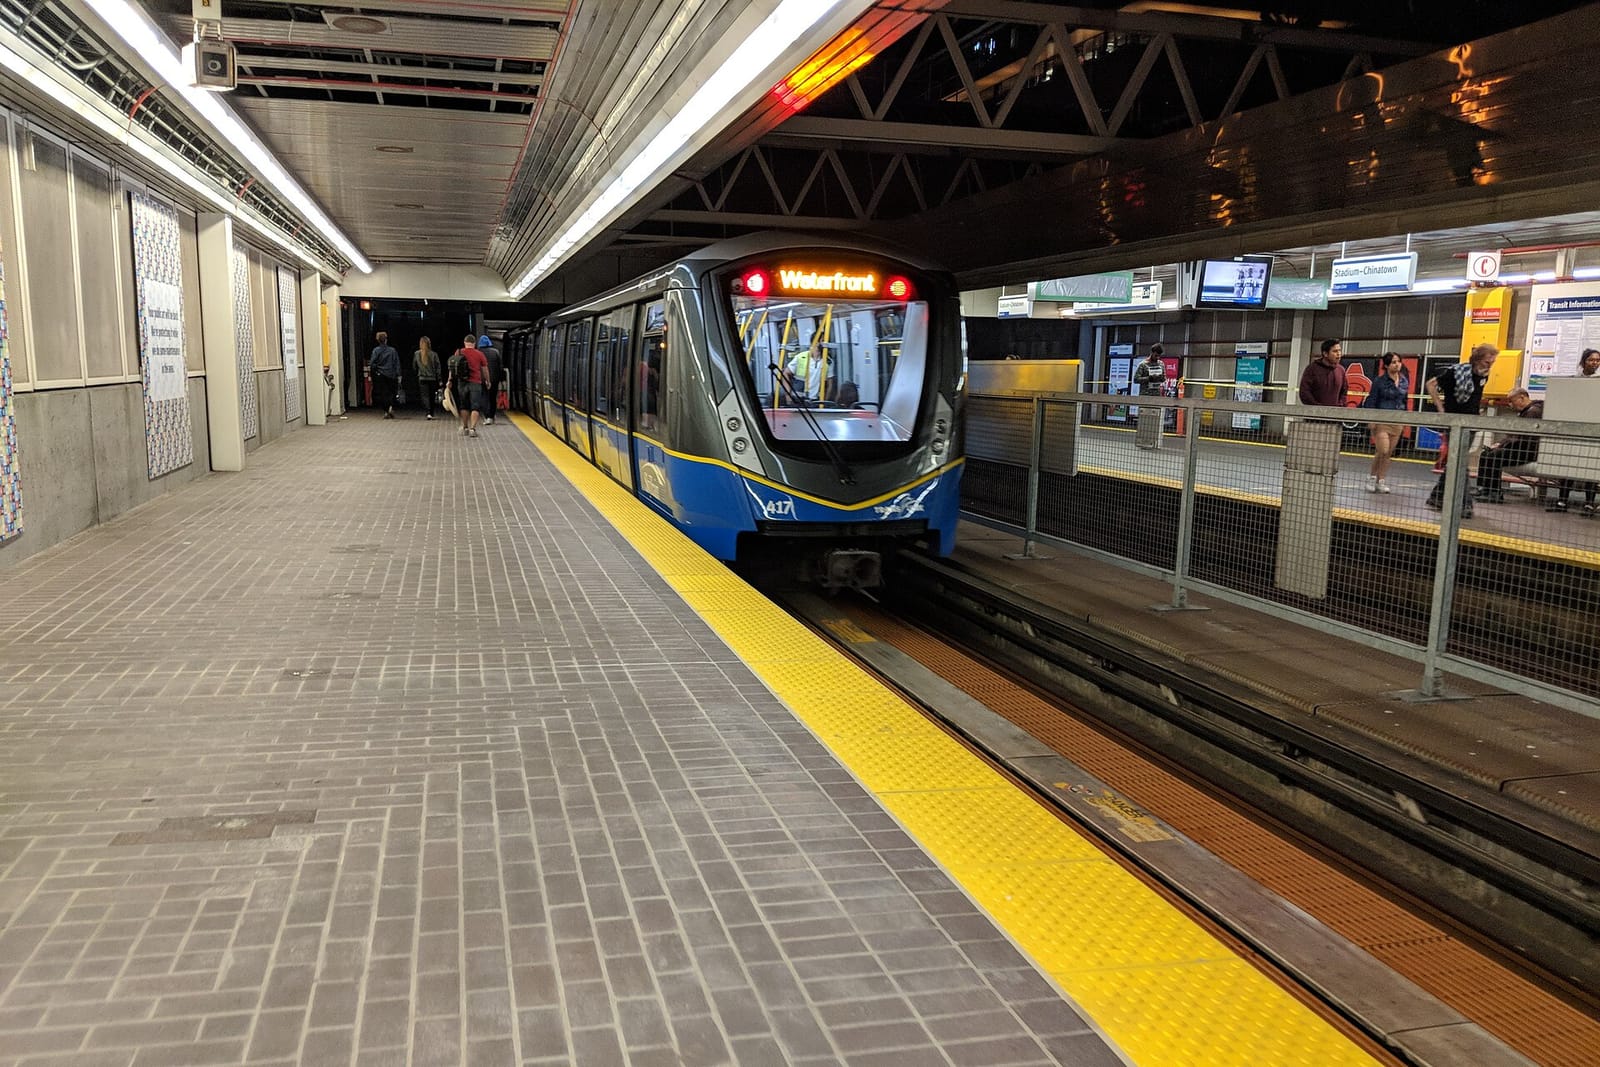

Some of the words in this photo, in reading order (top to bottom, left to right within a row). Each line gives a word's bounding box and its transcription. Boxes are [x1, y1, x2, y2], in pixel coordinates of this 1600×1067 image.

[779, 269, 876, 292] Waterfront
[1549, 300, 1569, 309] Transit
[766, 500, 792, 515] 417
